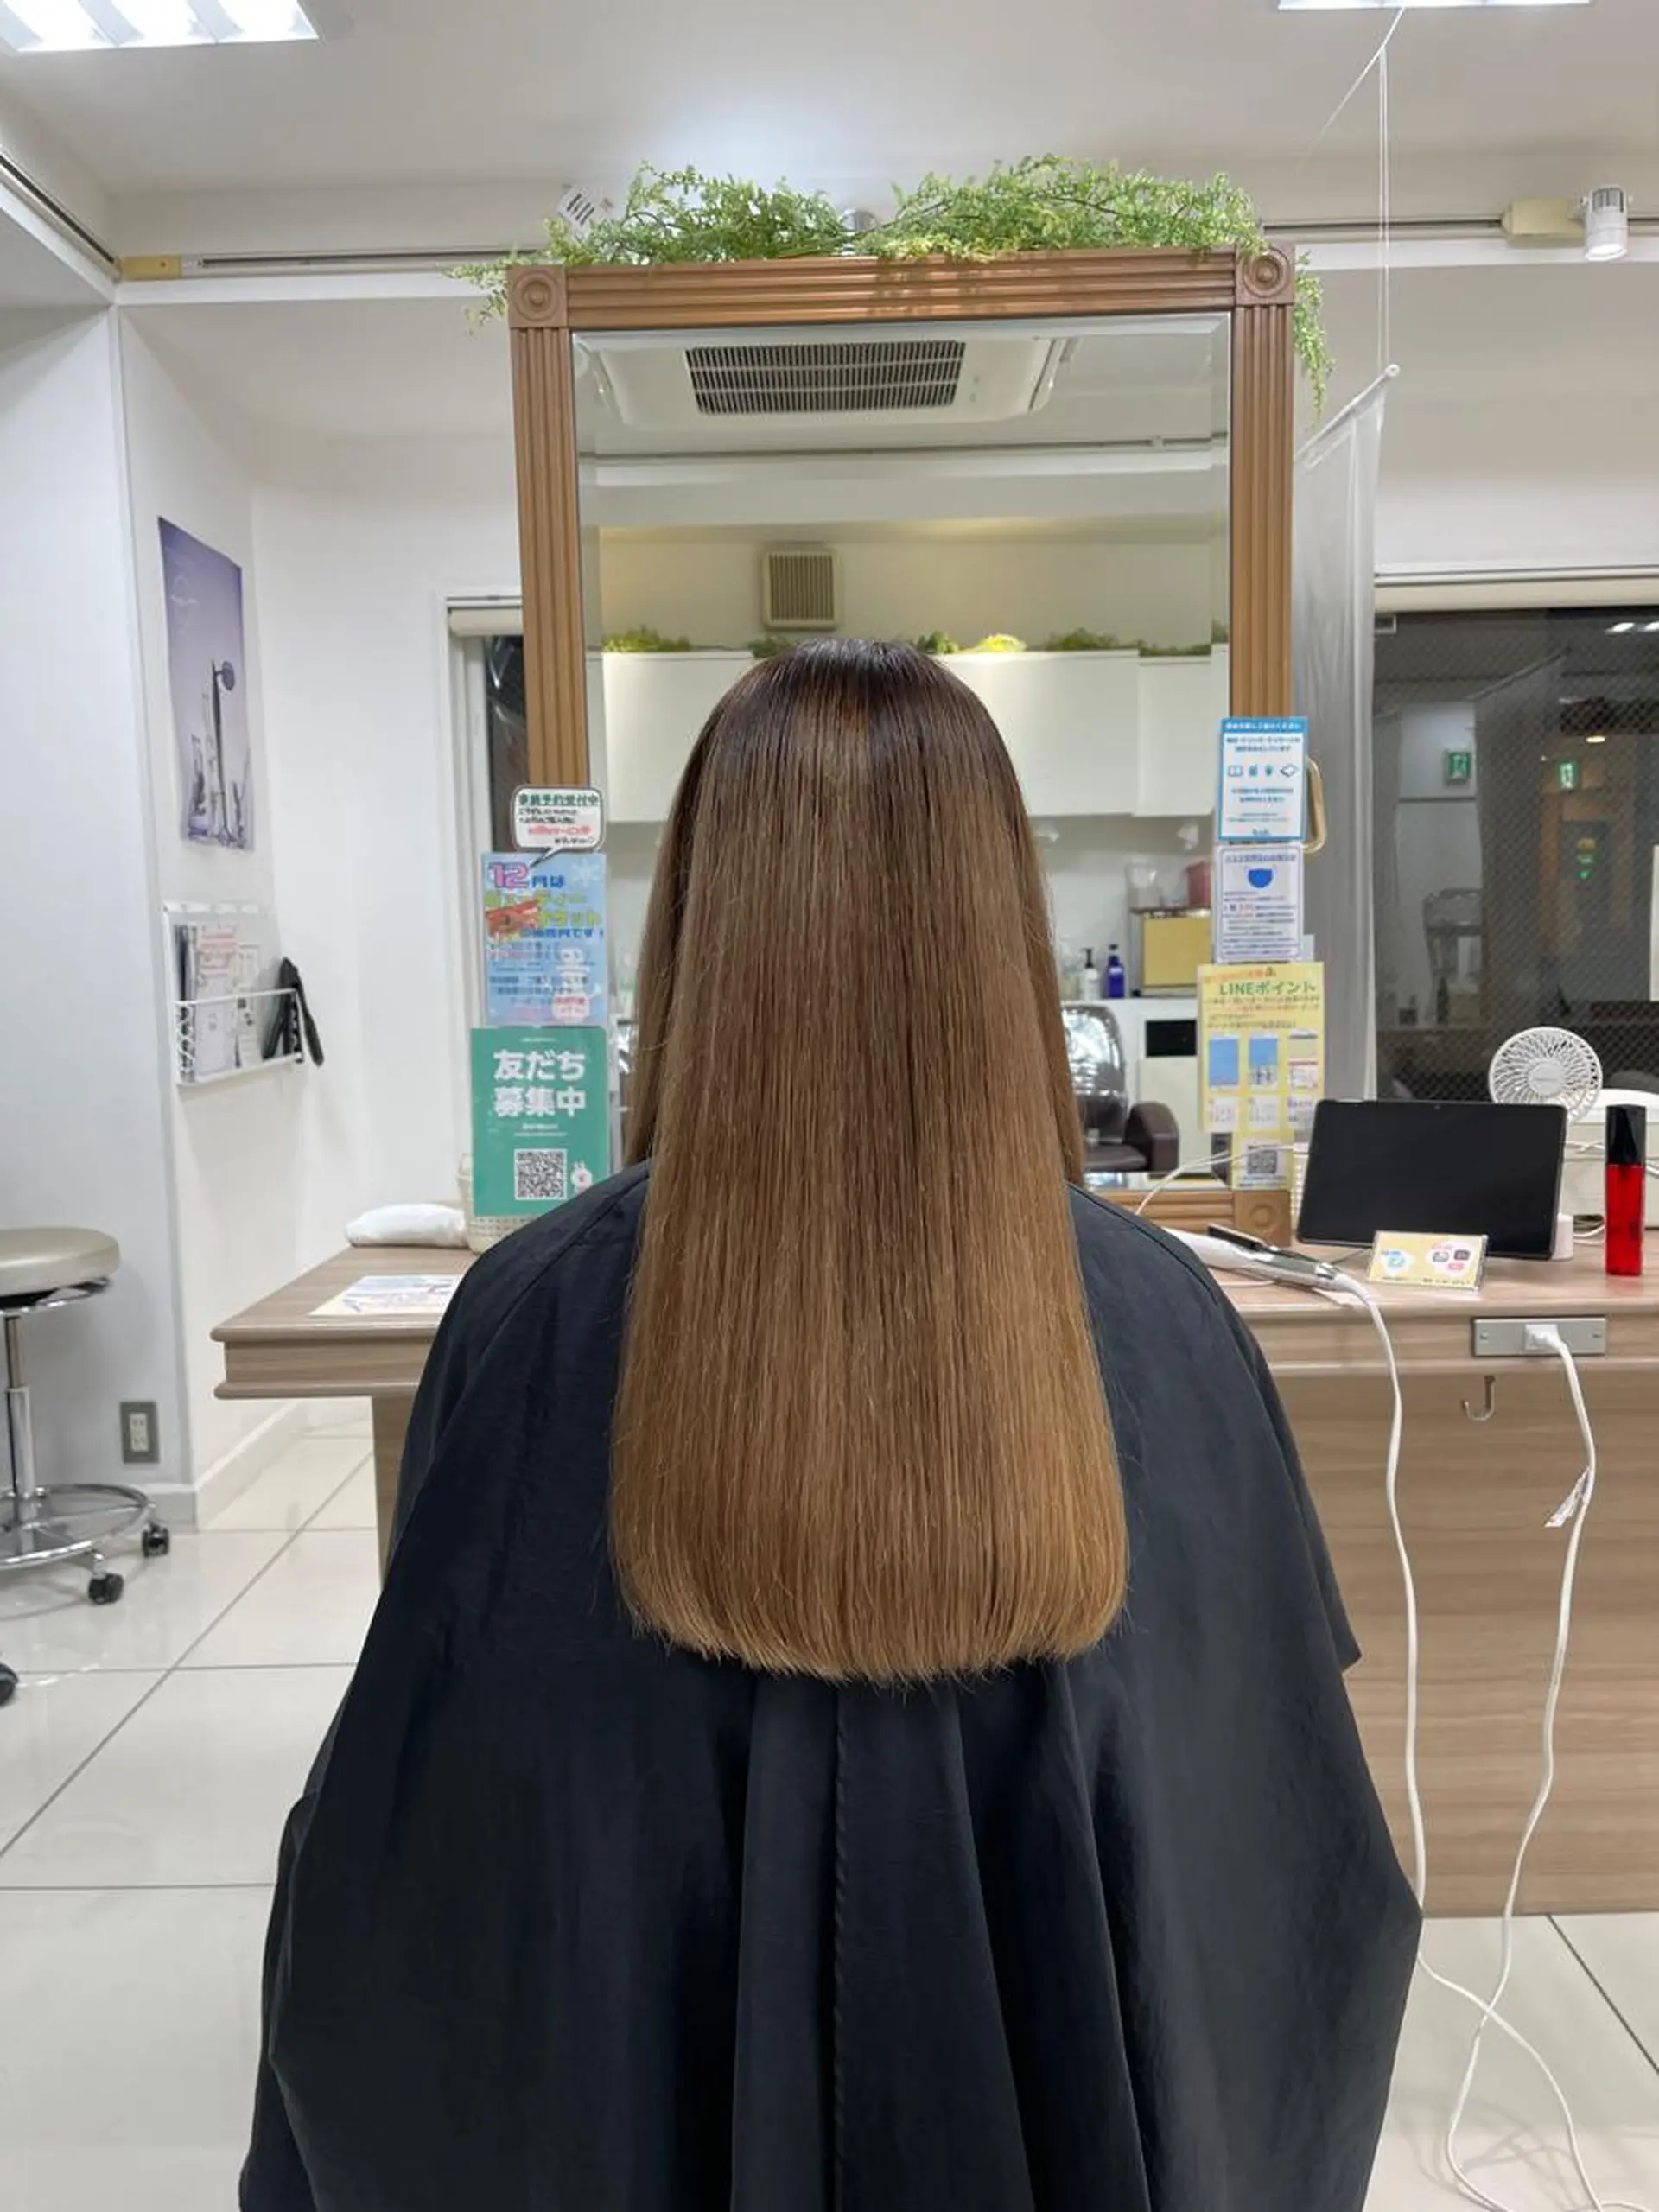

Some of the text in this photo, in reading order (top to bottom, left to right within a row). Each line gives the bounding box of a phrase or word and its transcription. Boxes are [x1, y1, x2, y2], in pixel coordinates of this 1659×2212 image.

[1220, 981, 1316, 995] LINEポイント
[493, 1049, 586, 1081] 友だち
[493, 1087, 586, 1118] 募集中
